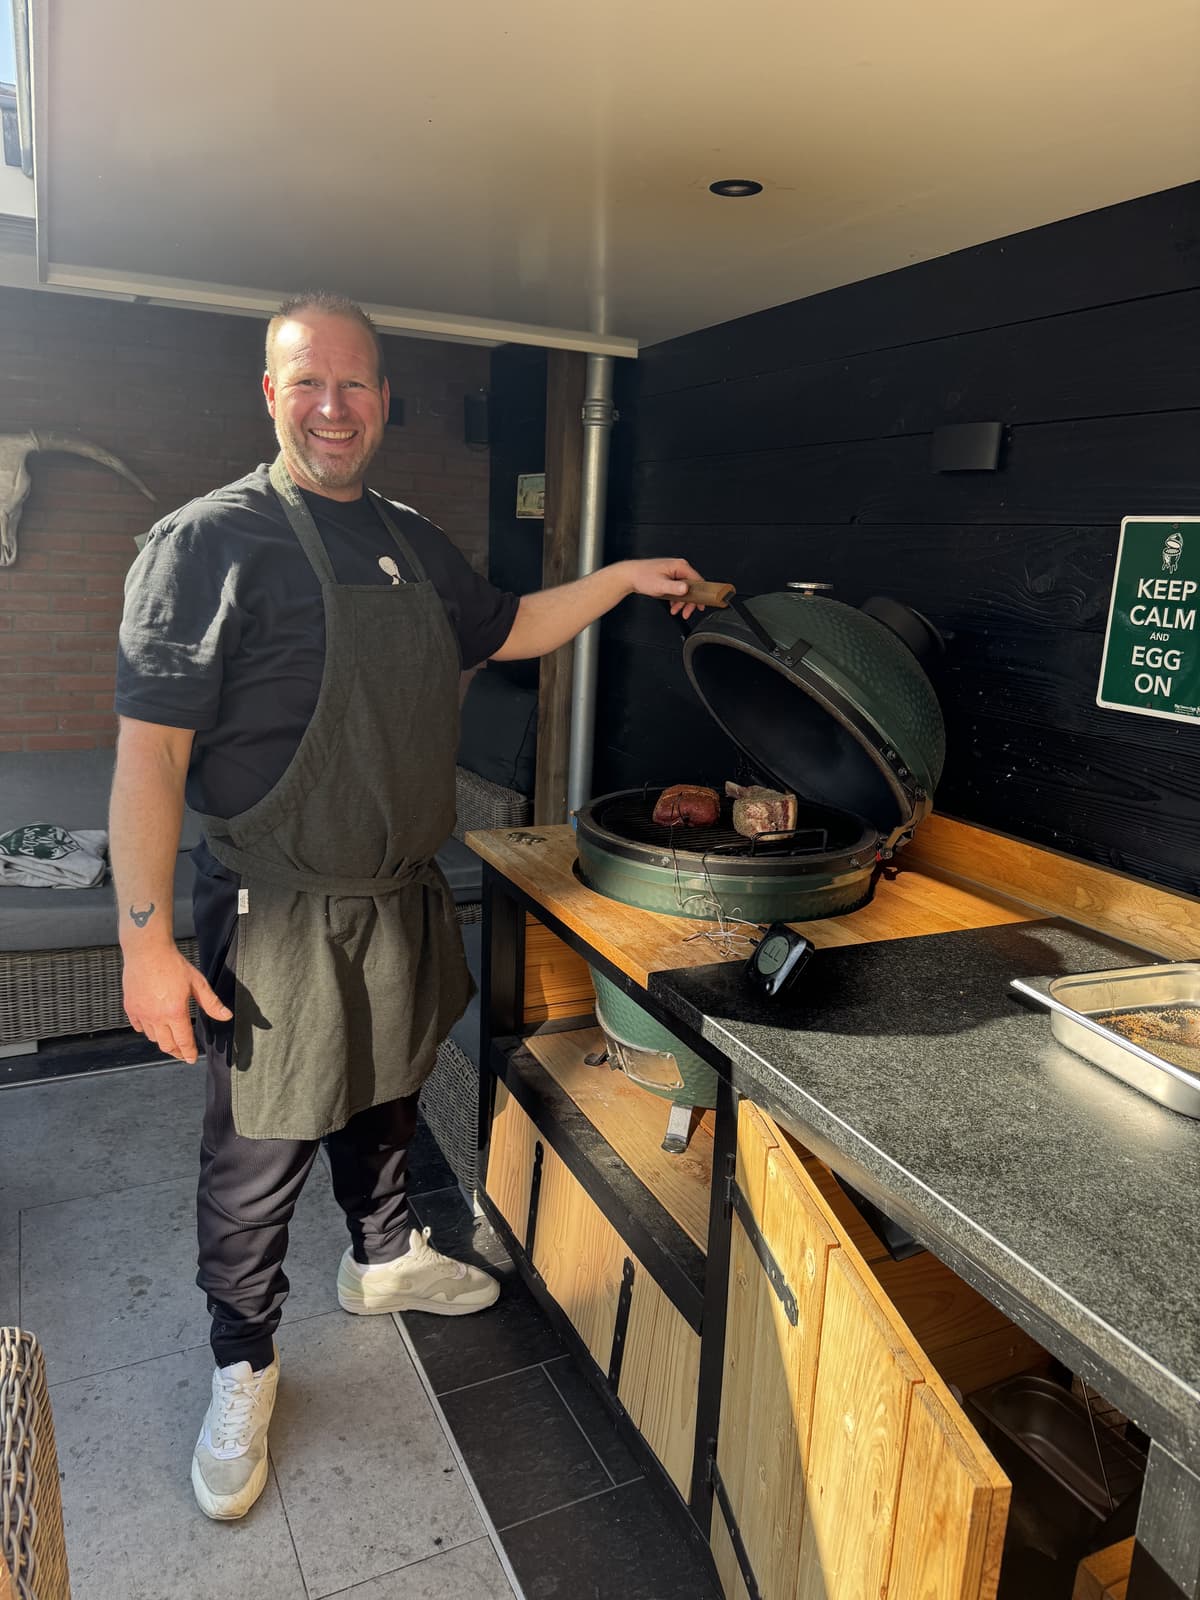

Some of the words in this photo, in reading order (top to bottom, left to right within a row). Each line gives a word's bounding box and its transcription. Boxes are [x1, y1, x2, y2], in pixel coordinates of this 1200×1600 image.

[1137, 578, 1197, 601] KEEP
[1130, 605, 1196, 630] CALM
[1150, 632, 1170, 641] AND
[1131, 645, 1181, 670] EGG
[1135, 673, 1172, 697] ON
